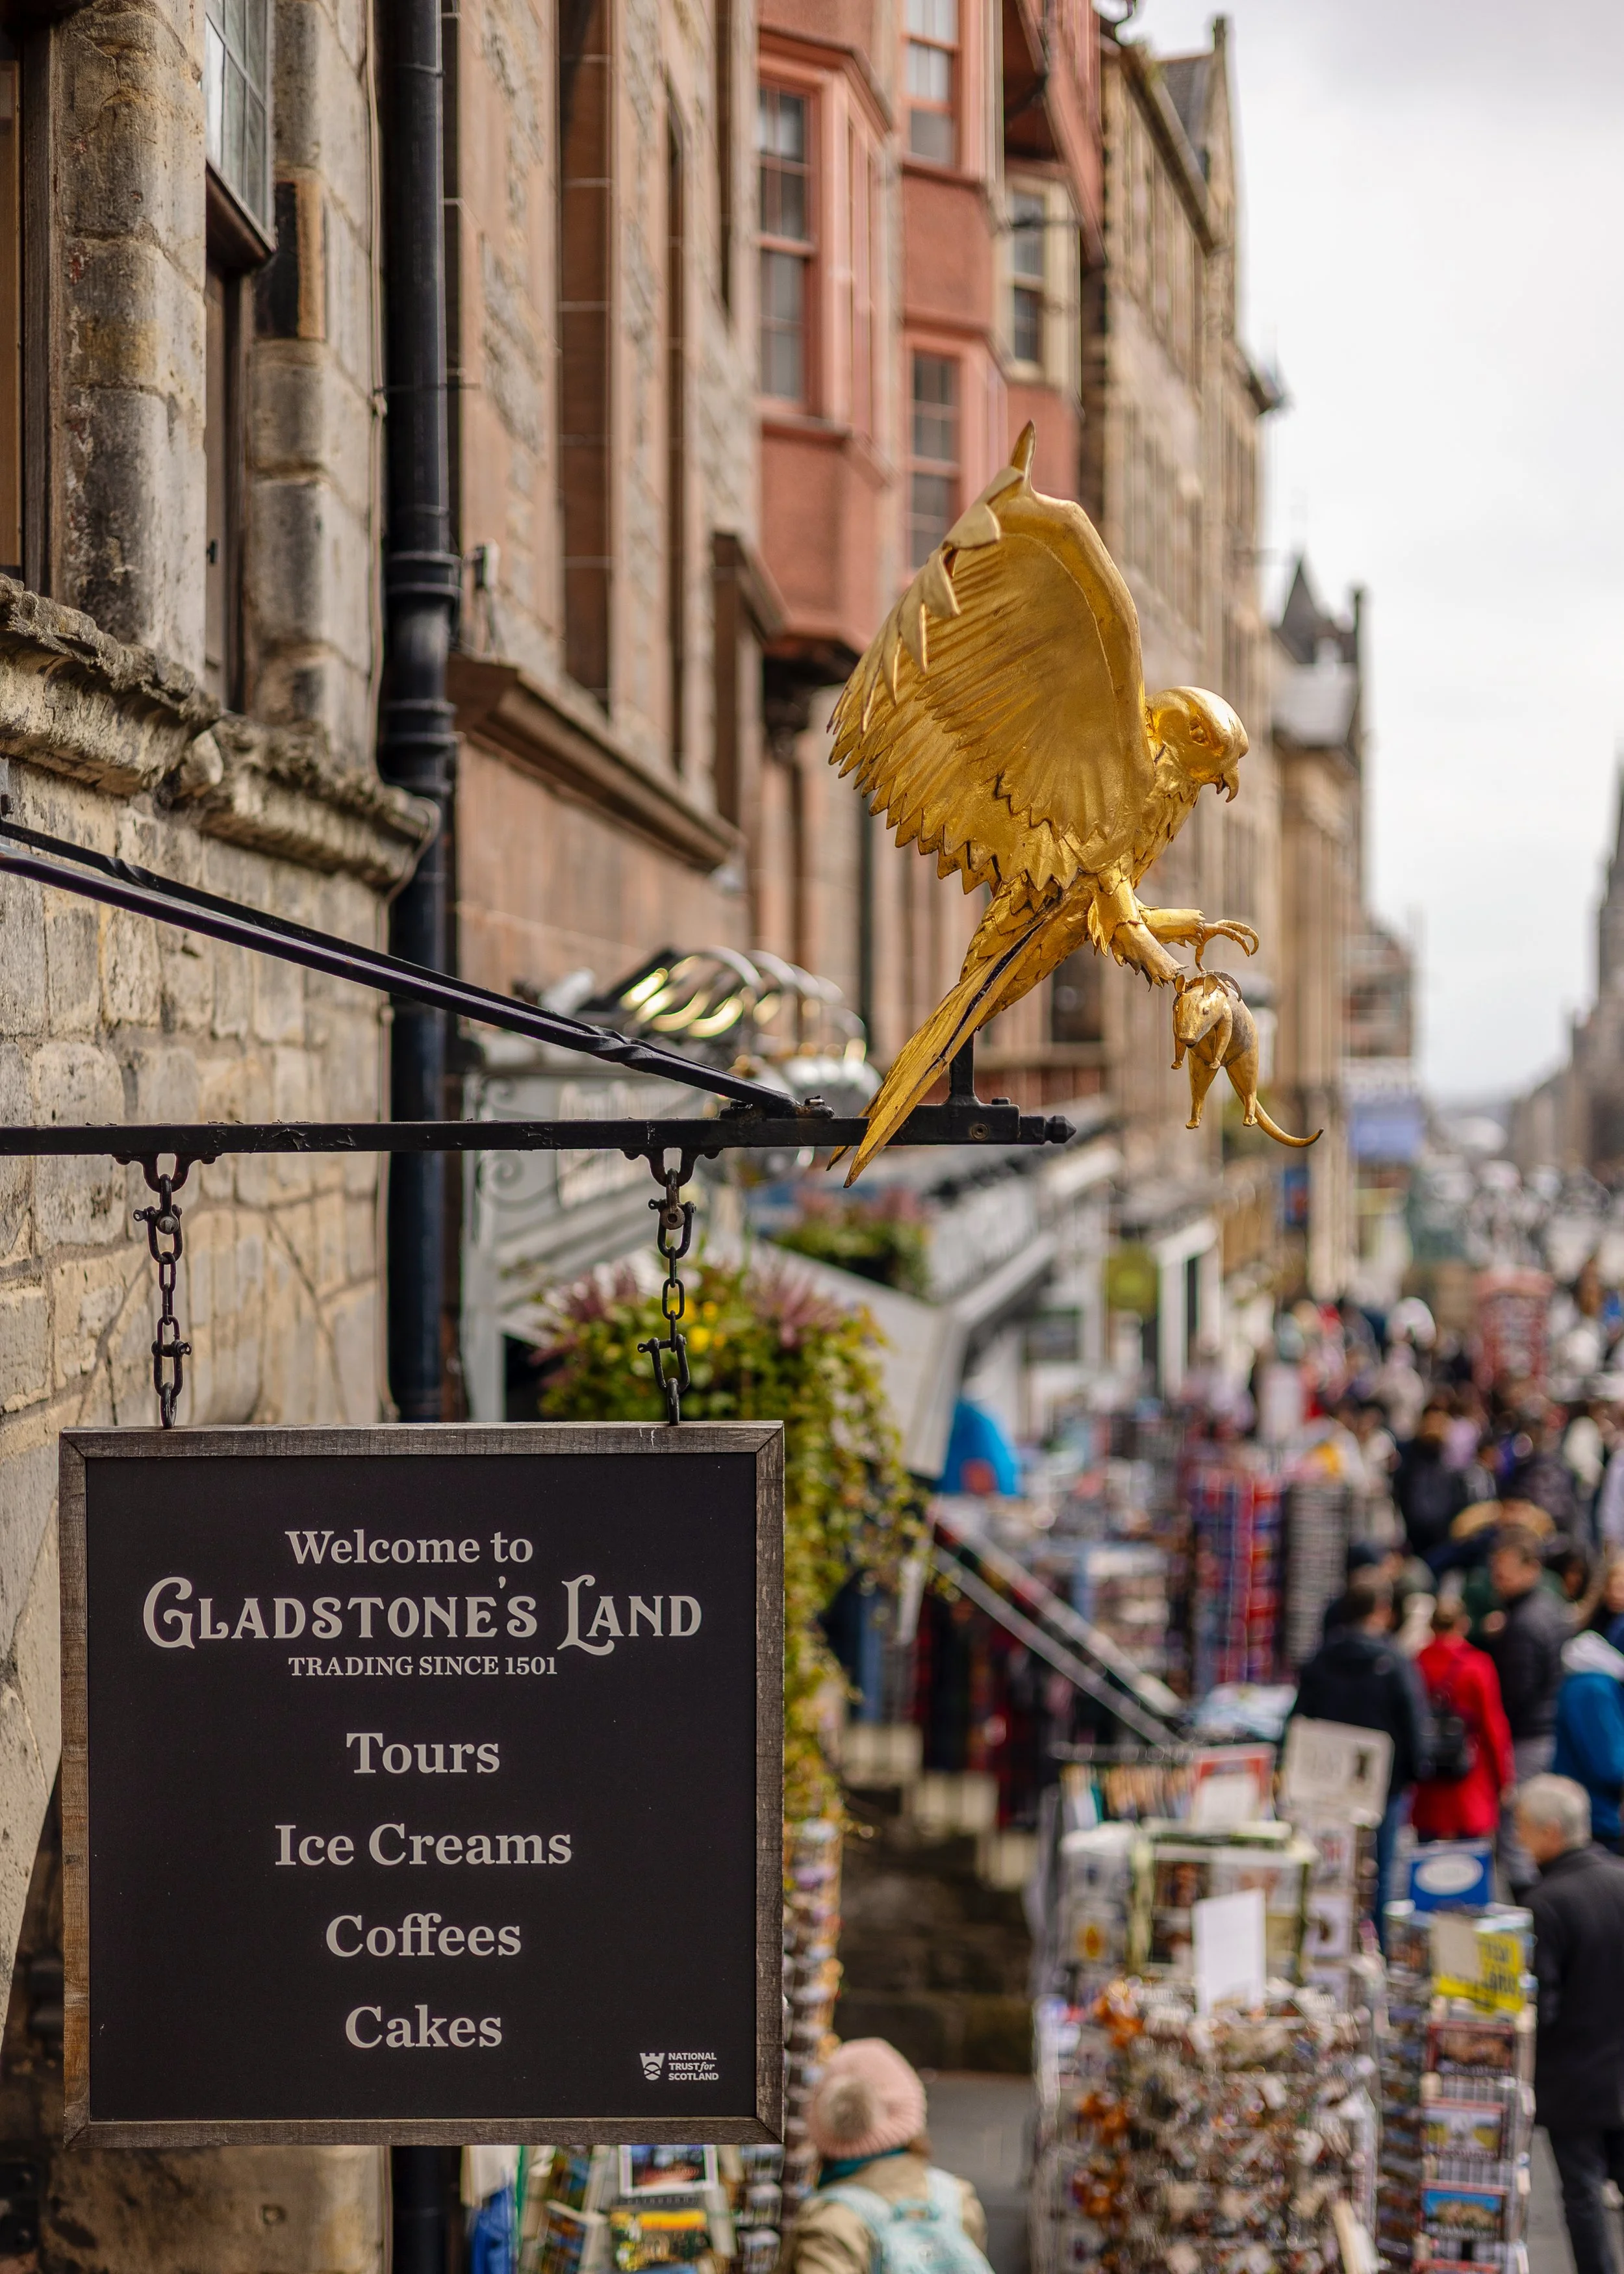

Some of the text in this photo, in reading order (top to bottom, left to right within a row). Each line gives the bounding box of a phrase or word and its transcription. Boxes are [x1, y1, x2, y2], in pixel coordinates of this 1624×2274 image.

[285, 1529, 533, 1565] Welcome to
[143, 1574, 702, 1656] GLADSTONE'S LAND
[288, 1655, 558, 1676] TRADING SINCE 1501
[346, 1732, 501, 1774] Tours
[275, 1822, 572, 1866] Ice Creams
[325, 1912, 522, 1958] Coffees
[345, 2004, 503, 2049] Cakes
[668, 2052, 717, 2061] NATIONAL
[668, 2061, 716, 2073] TRUST for
[668, 2072, 719, 2081] SCOTLAND
